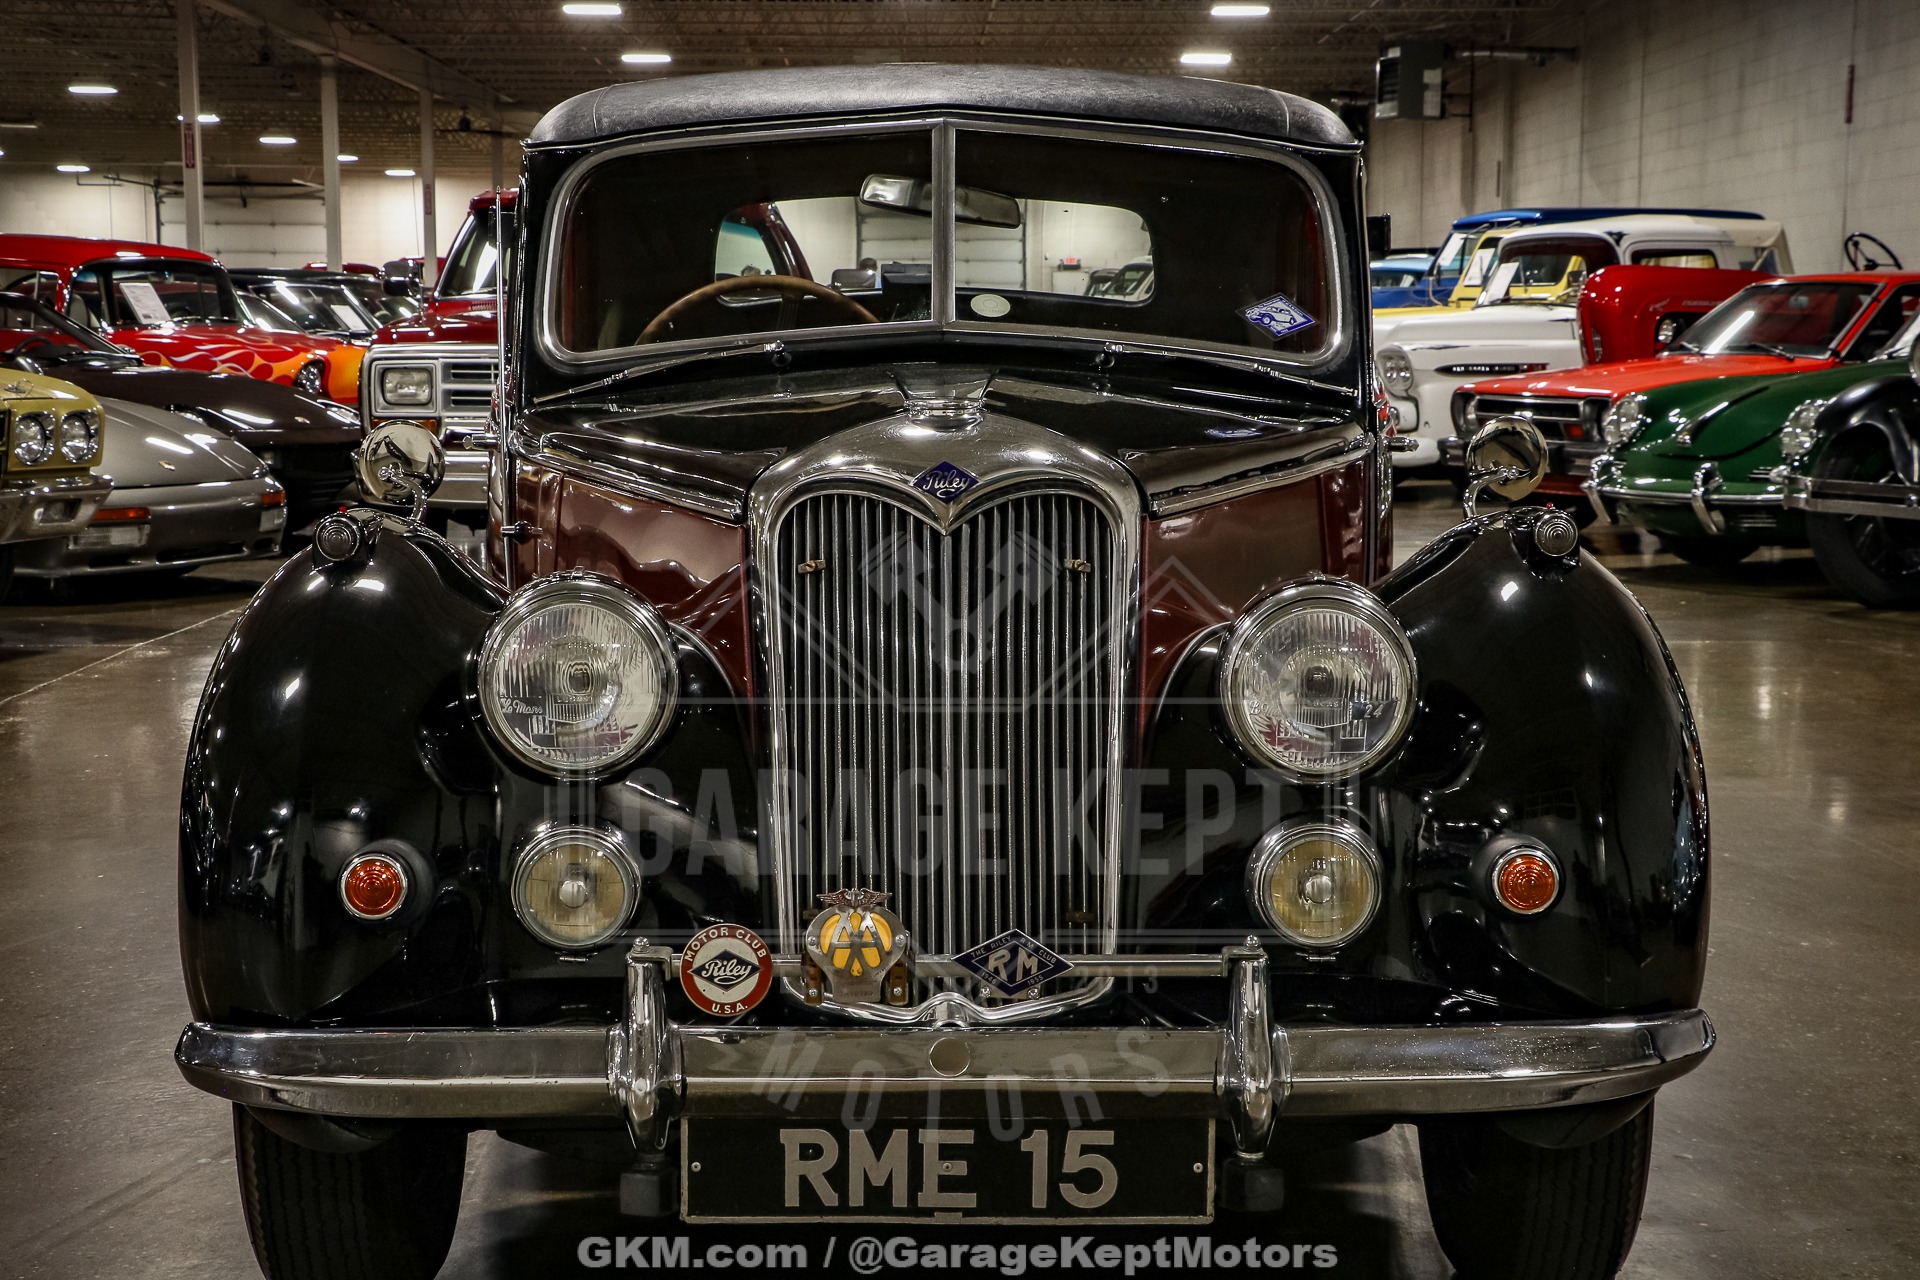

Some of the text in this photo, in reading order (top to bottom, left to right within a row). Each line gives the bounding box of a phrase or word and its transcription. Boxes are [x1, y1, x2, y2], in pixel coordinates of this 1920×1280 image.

[923, 470, 970, 498] Riley
[1364, 704, 1385, 718] 24
[684, 927, 767, 962] MOTOR CLUB
[824, 911, 887, 978] AA
[971, 947, 987, 958] THE
[990, 935, 1012, 949] RILEY
[1038, 949, 1057, 965] CLUB
[701, 958, 753, 985] Riley
[988, 947, 1039, 982] RM
[711, 1002, 749, 1014] U.S.A.
[779, 1128, 1119, 1209] RME 15
